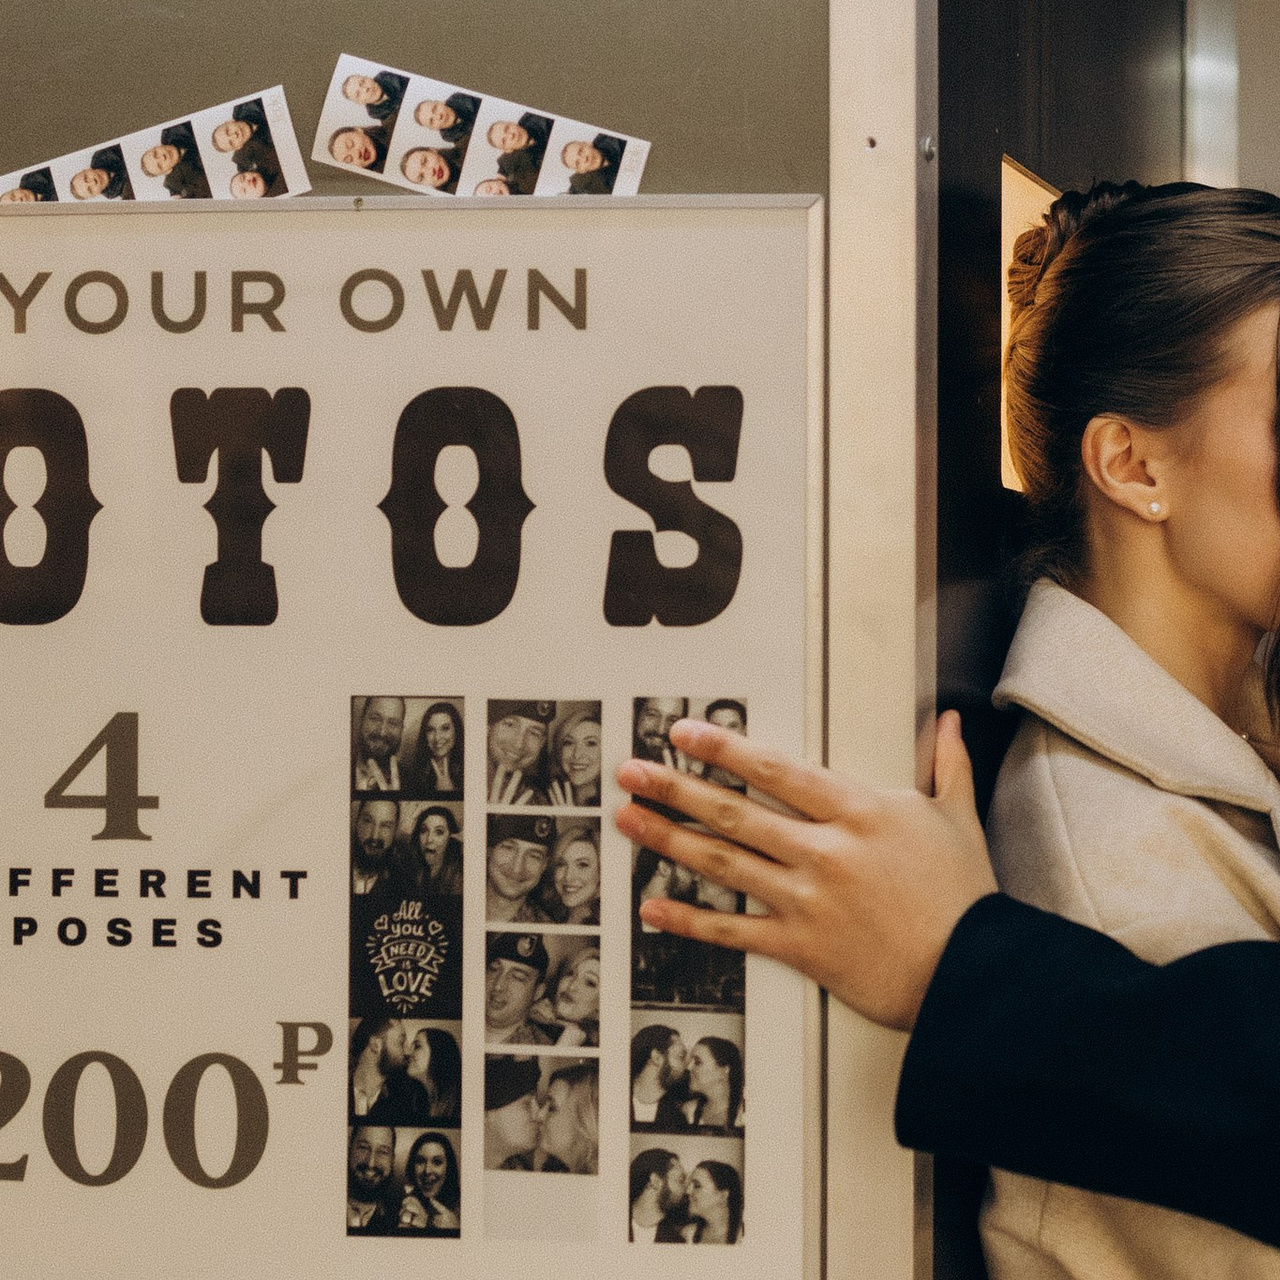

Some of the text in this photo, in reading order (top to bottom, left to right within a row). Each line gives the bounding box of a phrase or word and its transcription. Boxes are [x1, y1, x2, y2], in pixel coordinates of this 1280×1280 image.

[0, 269, 588, 335] YOUR OWN
[0, 385, 744, 627] OTOS
[44, 712, 160, 842] 4
[9, 868, 308, 900] FFERENT
[13, 917, 223, 949] POSES
[390, 942, 427, 958] NEED
[379, 971, 437, 997] LOVE
